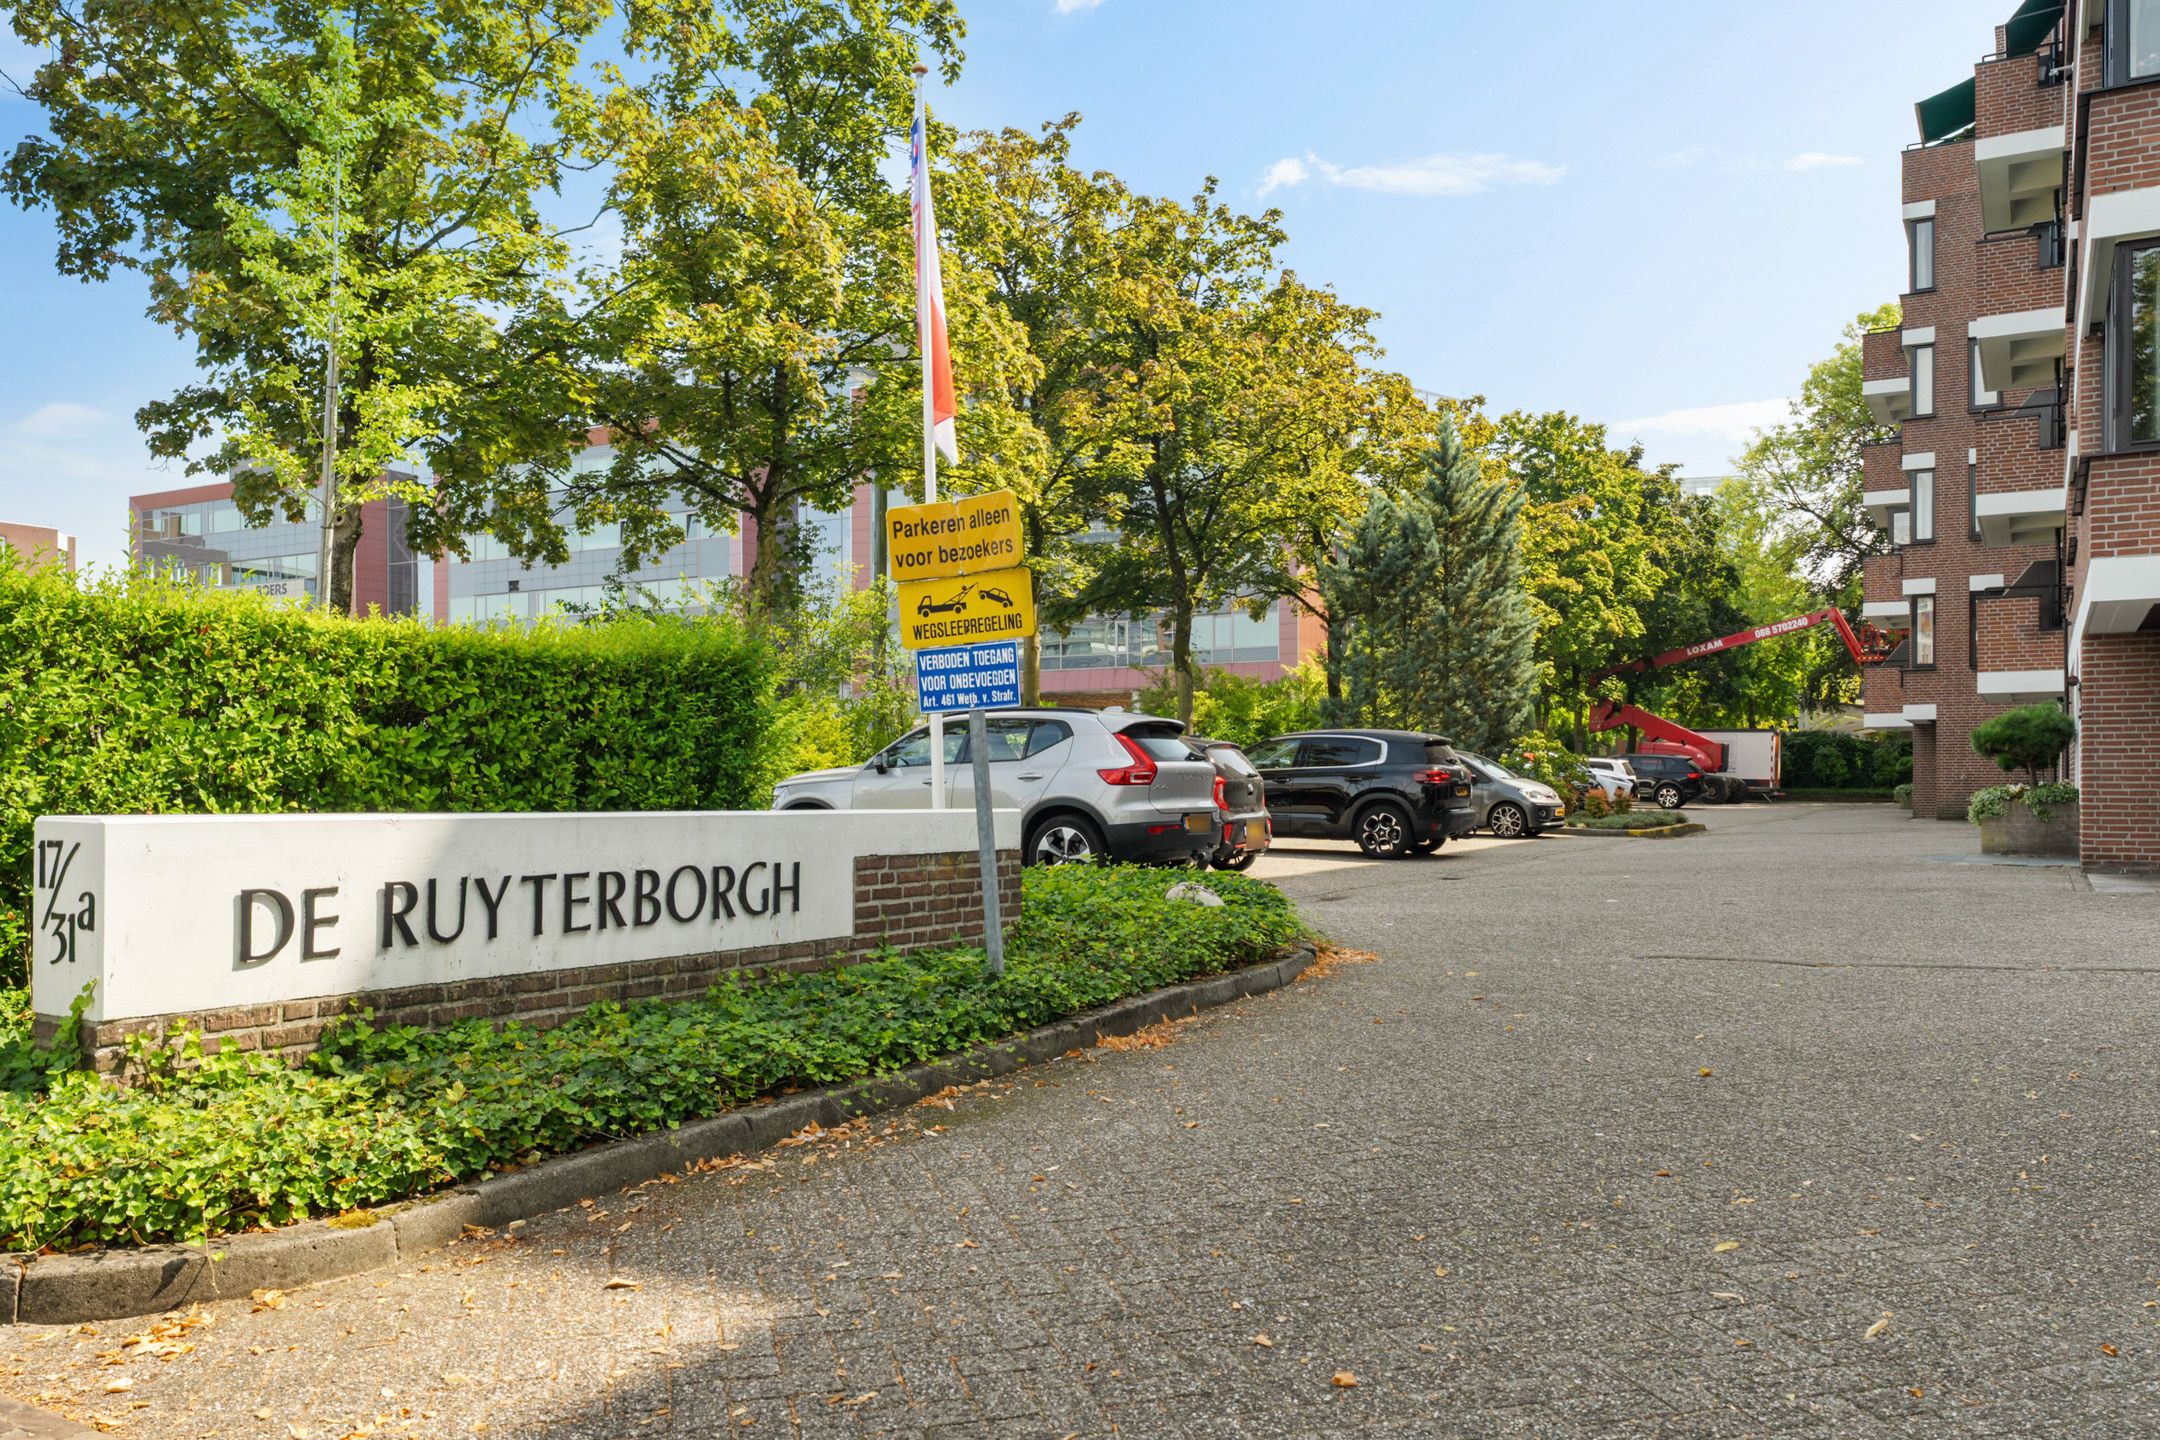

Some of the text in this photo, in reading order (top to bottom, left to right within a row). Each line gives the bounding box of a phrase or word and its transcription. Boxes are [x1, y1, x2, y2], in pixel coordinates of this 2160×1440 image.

[892, 508, 1010, 539] Parkeren alleen
[895, 538, 1014, 568] voor bezoekers
[912, 613, 1023, 640] WEGSLEEPREGELING
[1754, 617, 1808, 638] 088 5702240
[919, 647, 1015, 671] VERBODEN TOEGANG
[1686, 639, 1723, 655] LOXAM
[920, 668, 1016, 692] VOOR ONBEVOEGDEN
[923, 695, 939, 707] Art.
[941, 693, 955, 706] 461
[239, 861, 800, 964] DE RUYTERBORGH
